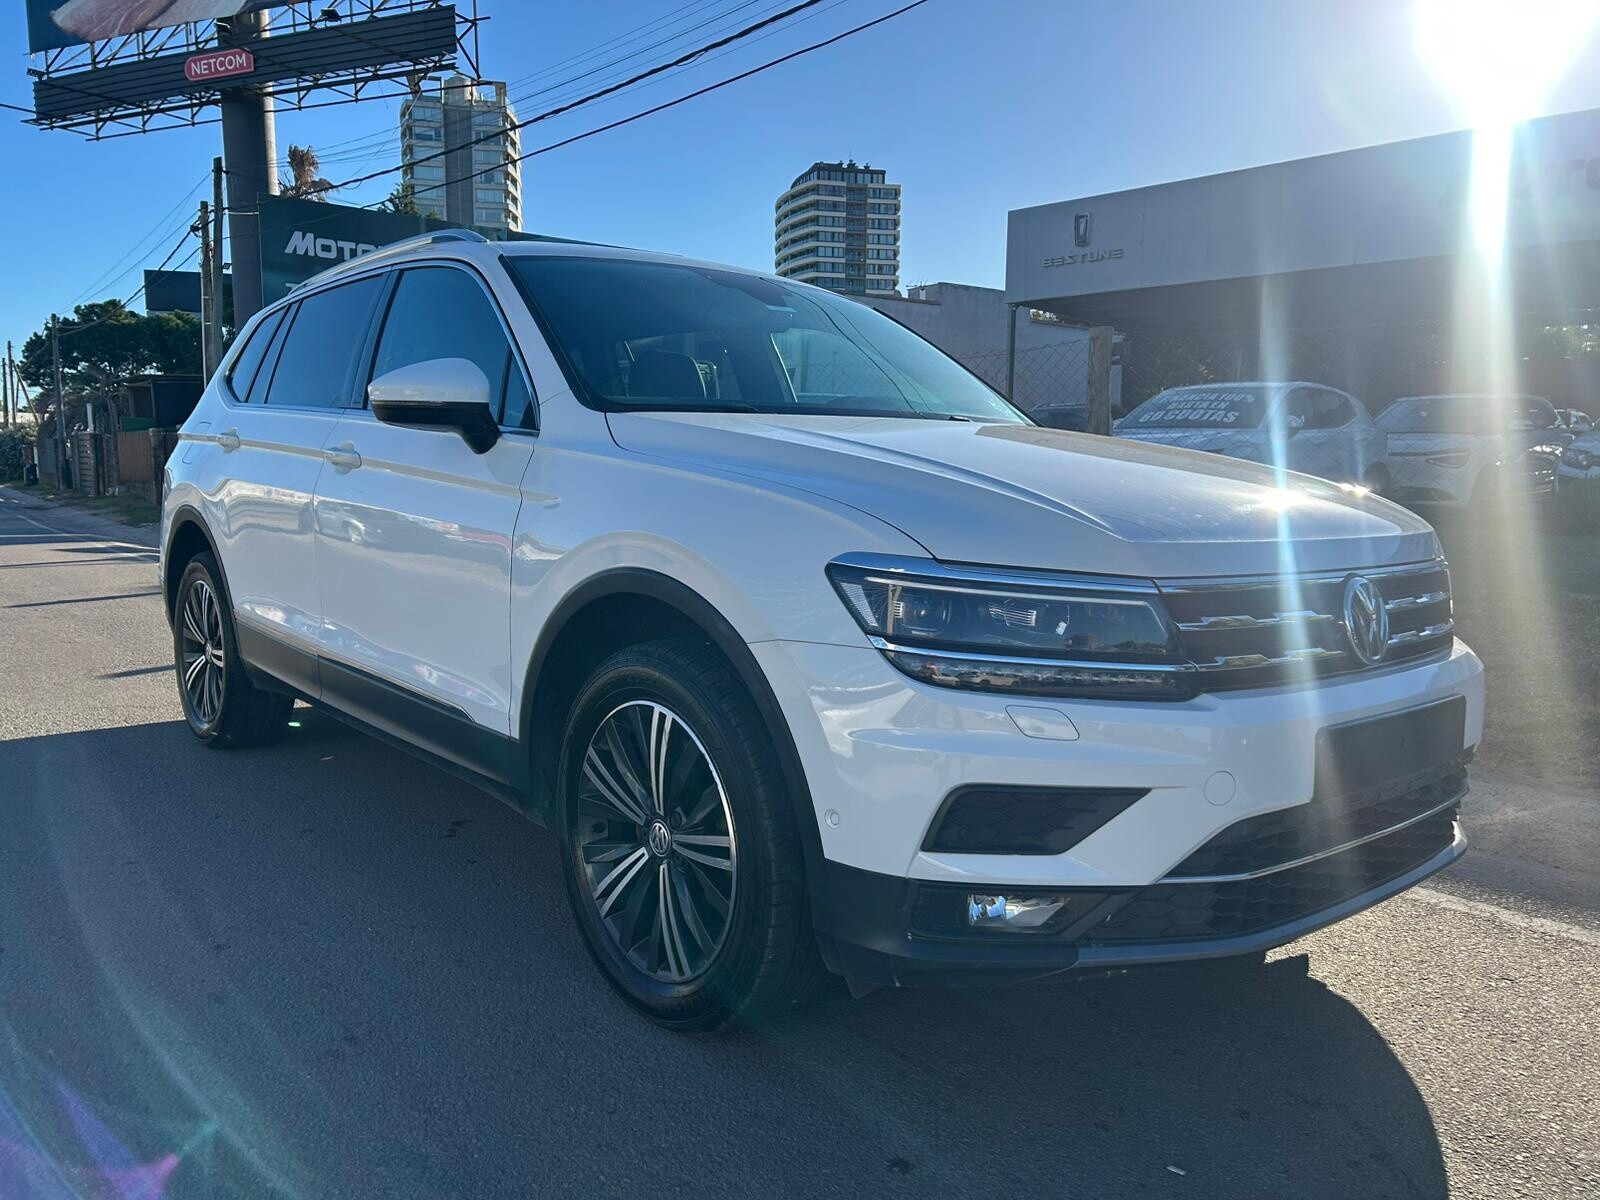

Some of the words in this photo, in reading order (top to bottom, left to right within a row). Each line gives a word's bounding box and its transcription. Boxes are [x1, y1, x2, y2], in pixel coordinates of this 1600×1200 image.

[190, 53, 247, 76] NETCOM
[285, 231, 384, 260] MOTO
[1043, 248, 1124, 268] BESTUNE
[1163, 409, 1240, 422] CUOTAS
